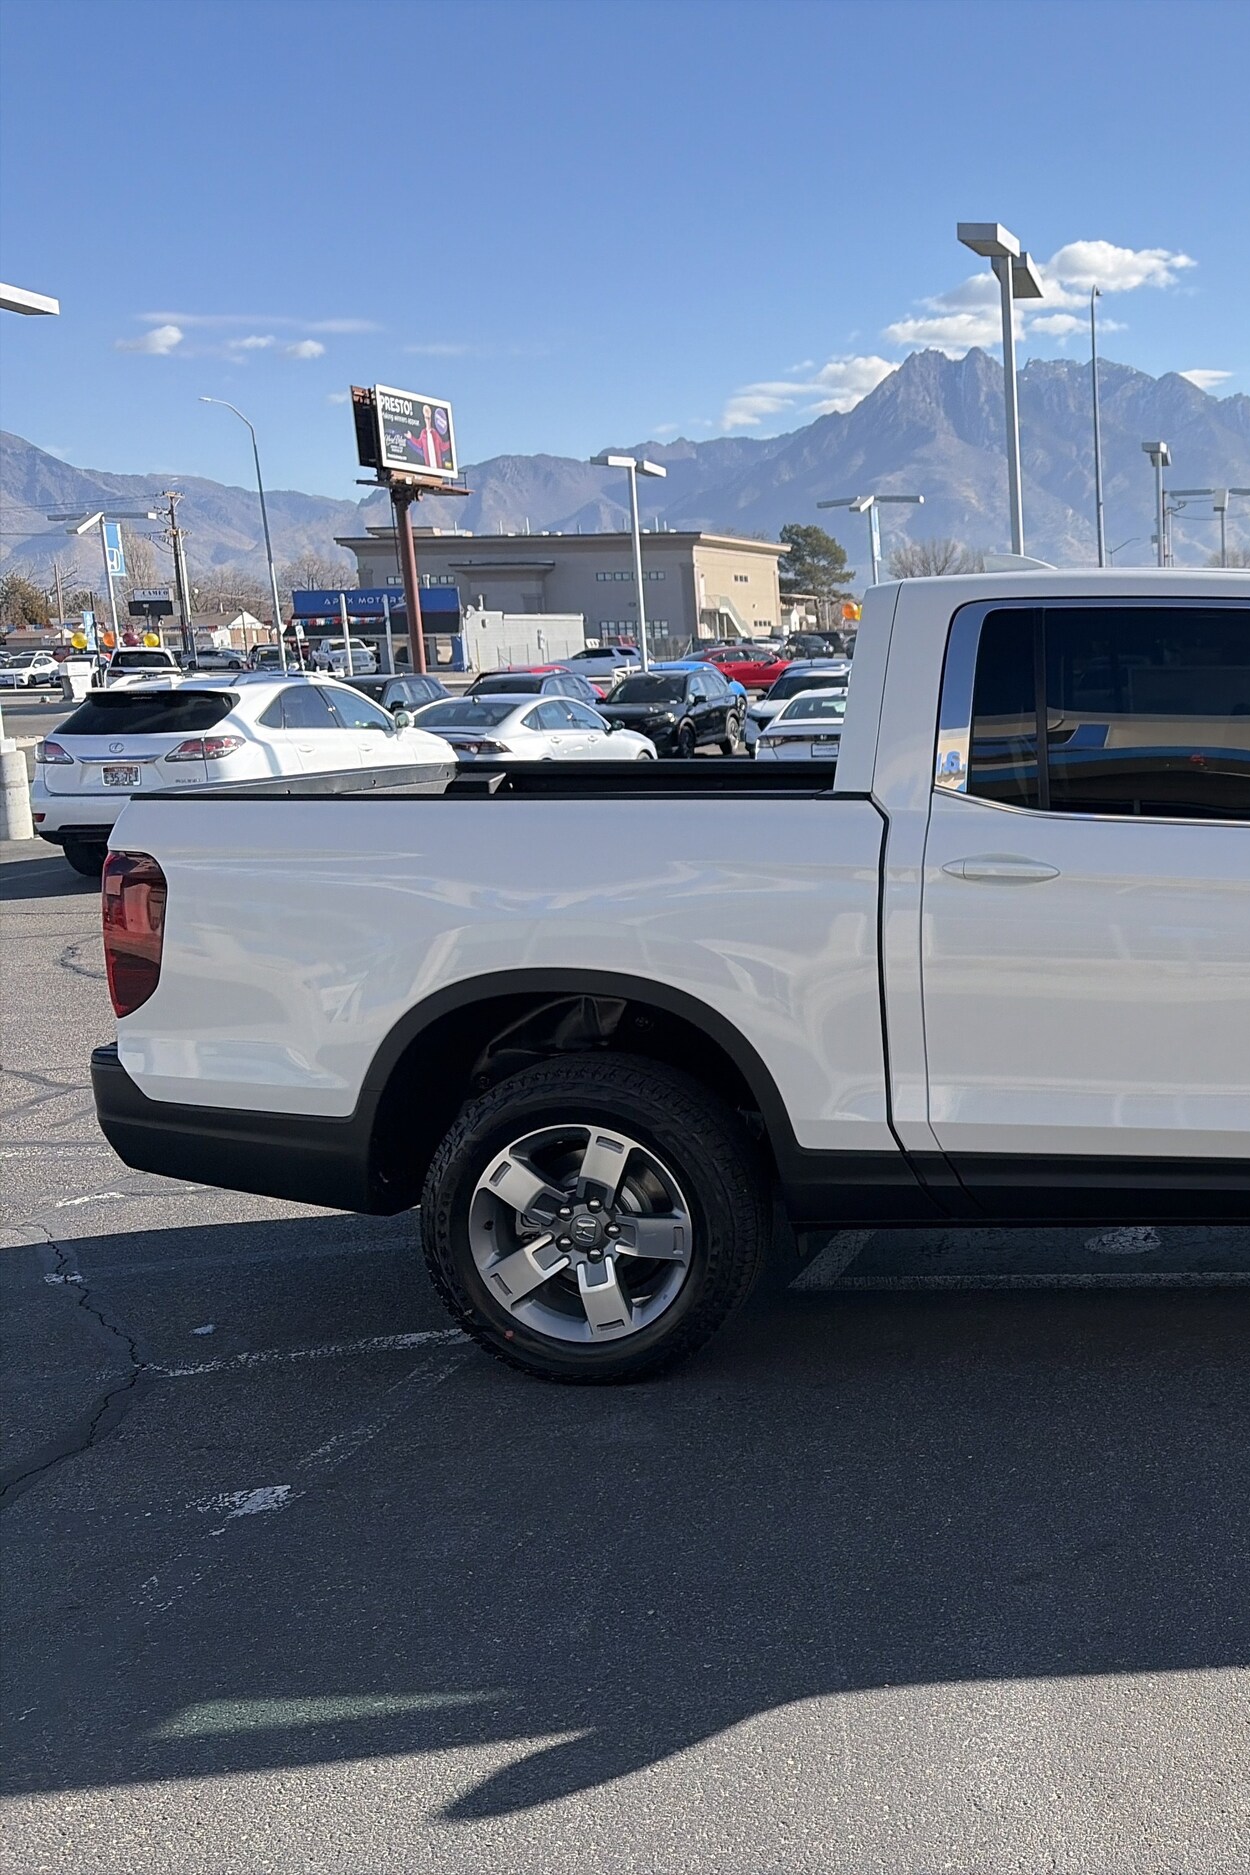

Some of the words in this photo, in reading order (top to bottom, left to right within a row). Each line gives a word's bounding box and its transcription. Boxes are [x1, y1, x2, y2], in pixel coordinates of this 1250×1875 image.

[380, 395, 413, 416] PRESTO!
[324, 597, 354, 605] APX
[358, 596, 405, 604] MOTRS
